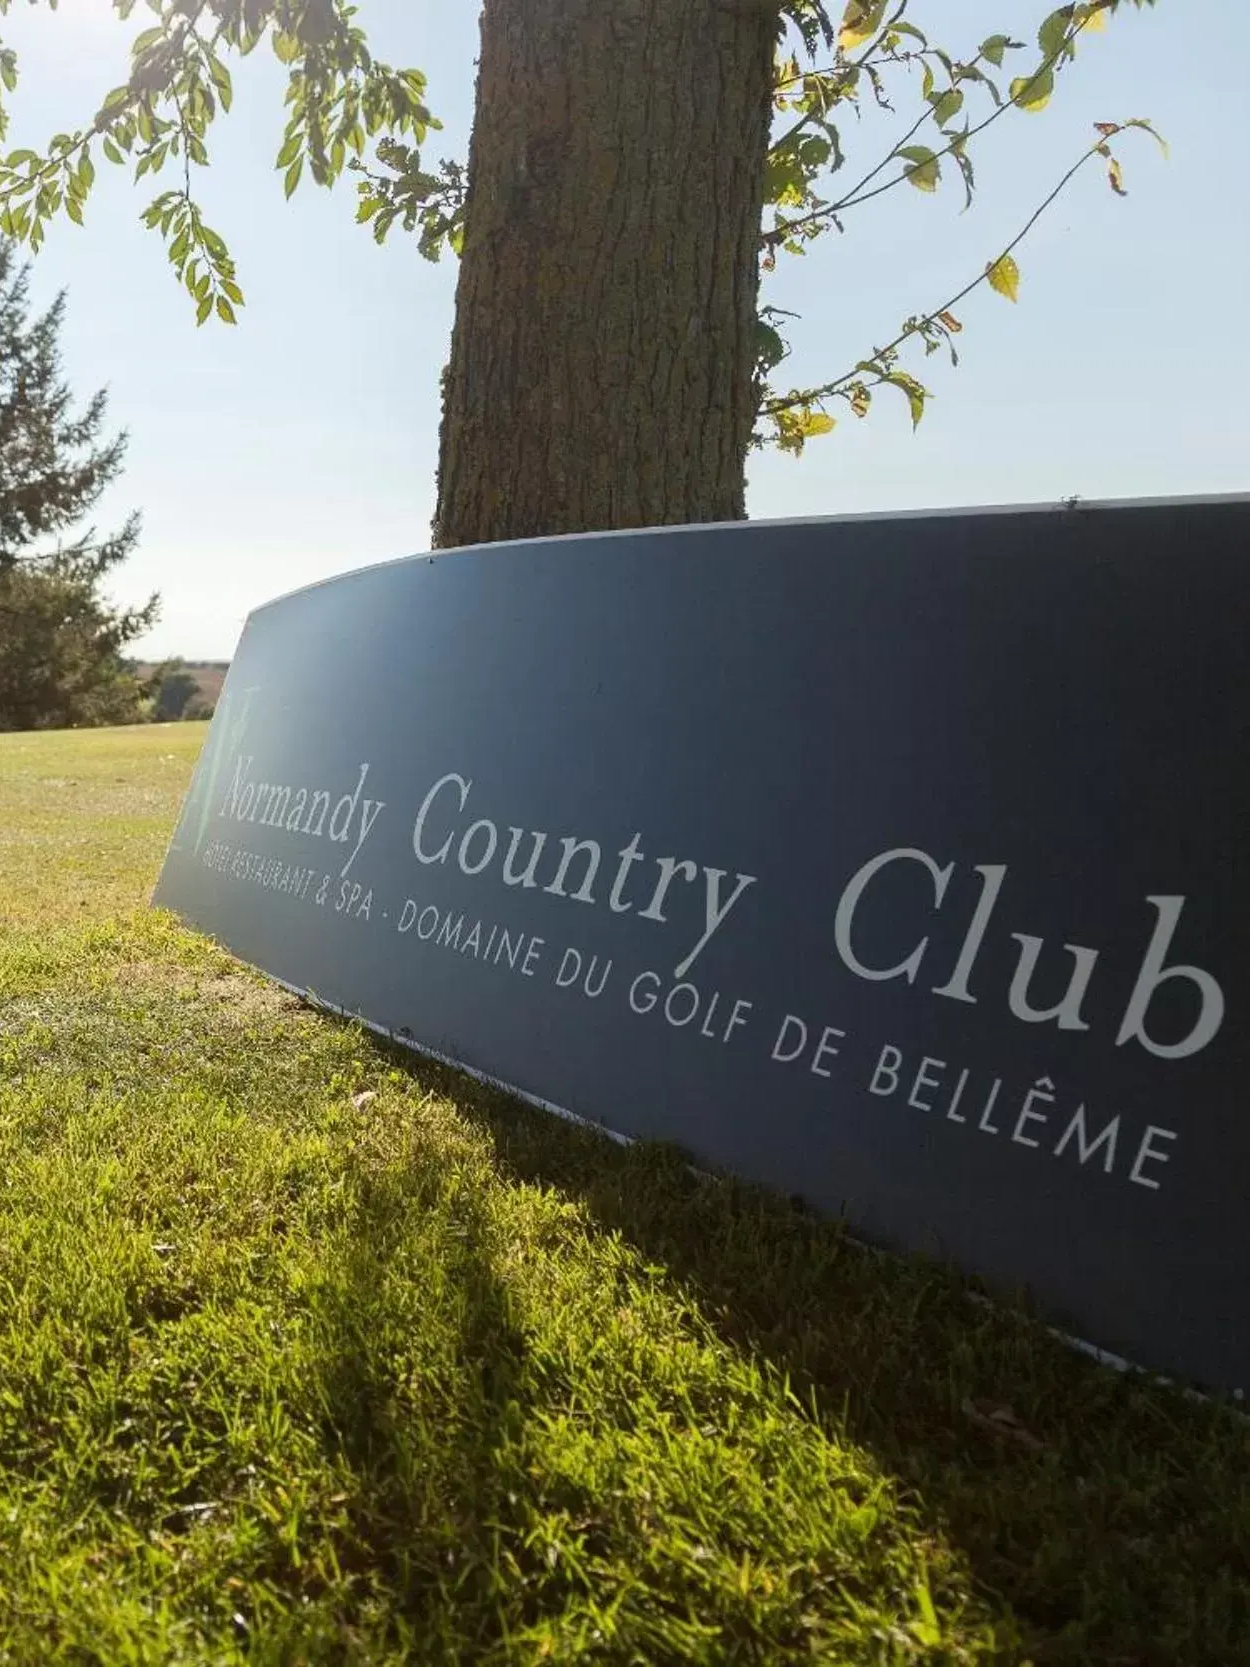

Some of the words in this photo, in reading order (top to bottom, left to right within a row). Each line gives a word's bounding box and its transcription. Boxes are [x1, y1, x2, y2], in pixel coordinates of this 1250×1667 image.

[218, 756, 386, 878] Normandy
[412, 773, 758, 979] Country
[834, 847, 1225, 1059] Club
[316, 875, 330, 905] &
[335, 880, 373, 921] SPA
[397, 900, 546, 977] DOMAINE
[556, 948, 613, 998] DU
[629, 971, 752, 1043] GOLF
[771, 1014, 846, 1078] DE
[869, 1044, 1178, 1190] BELLÊME
